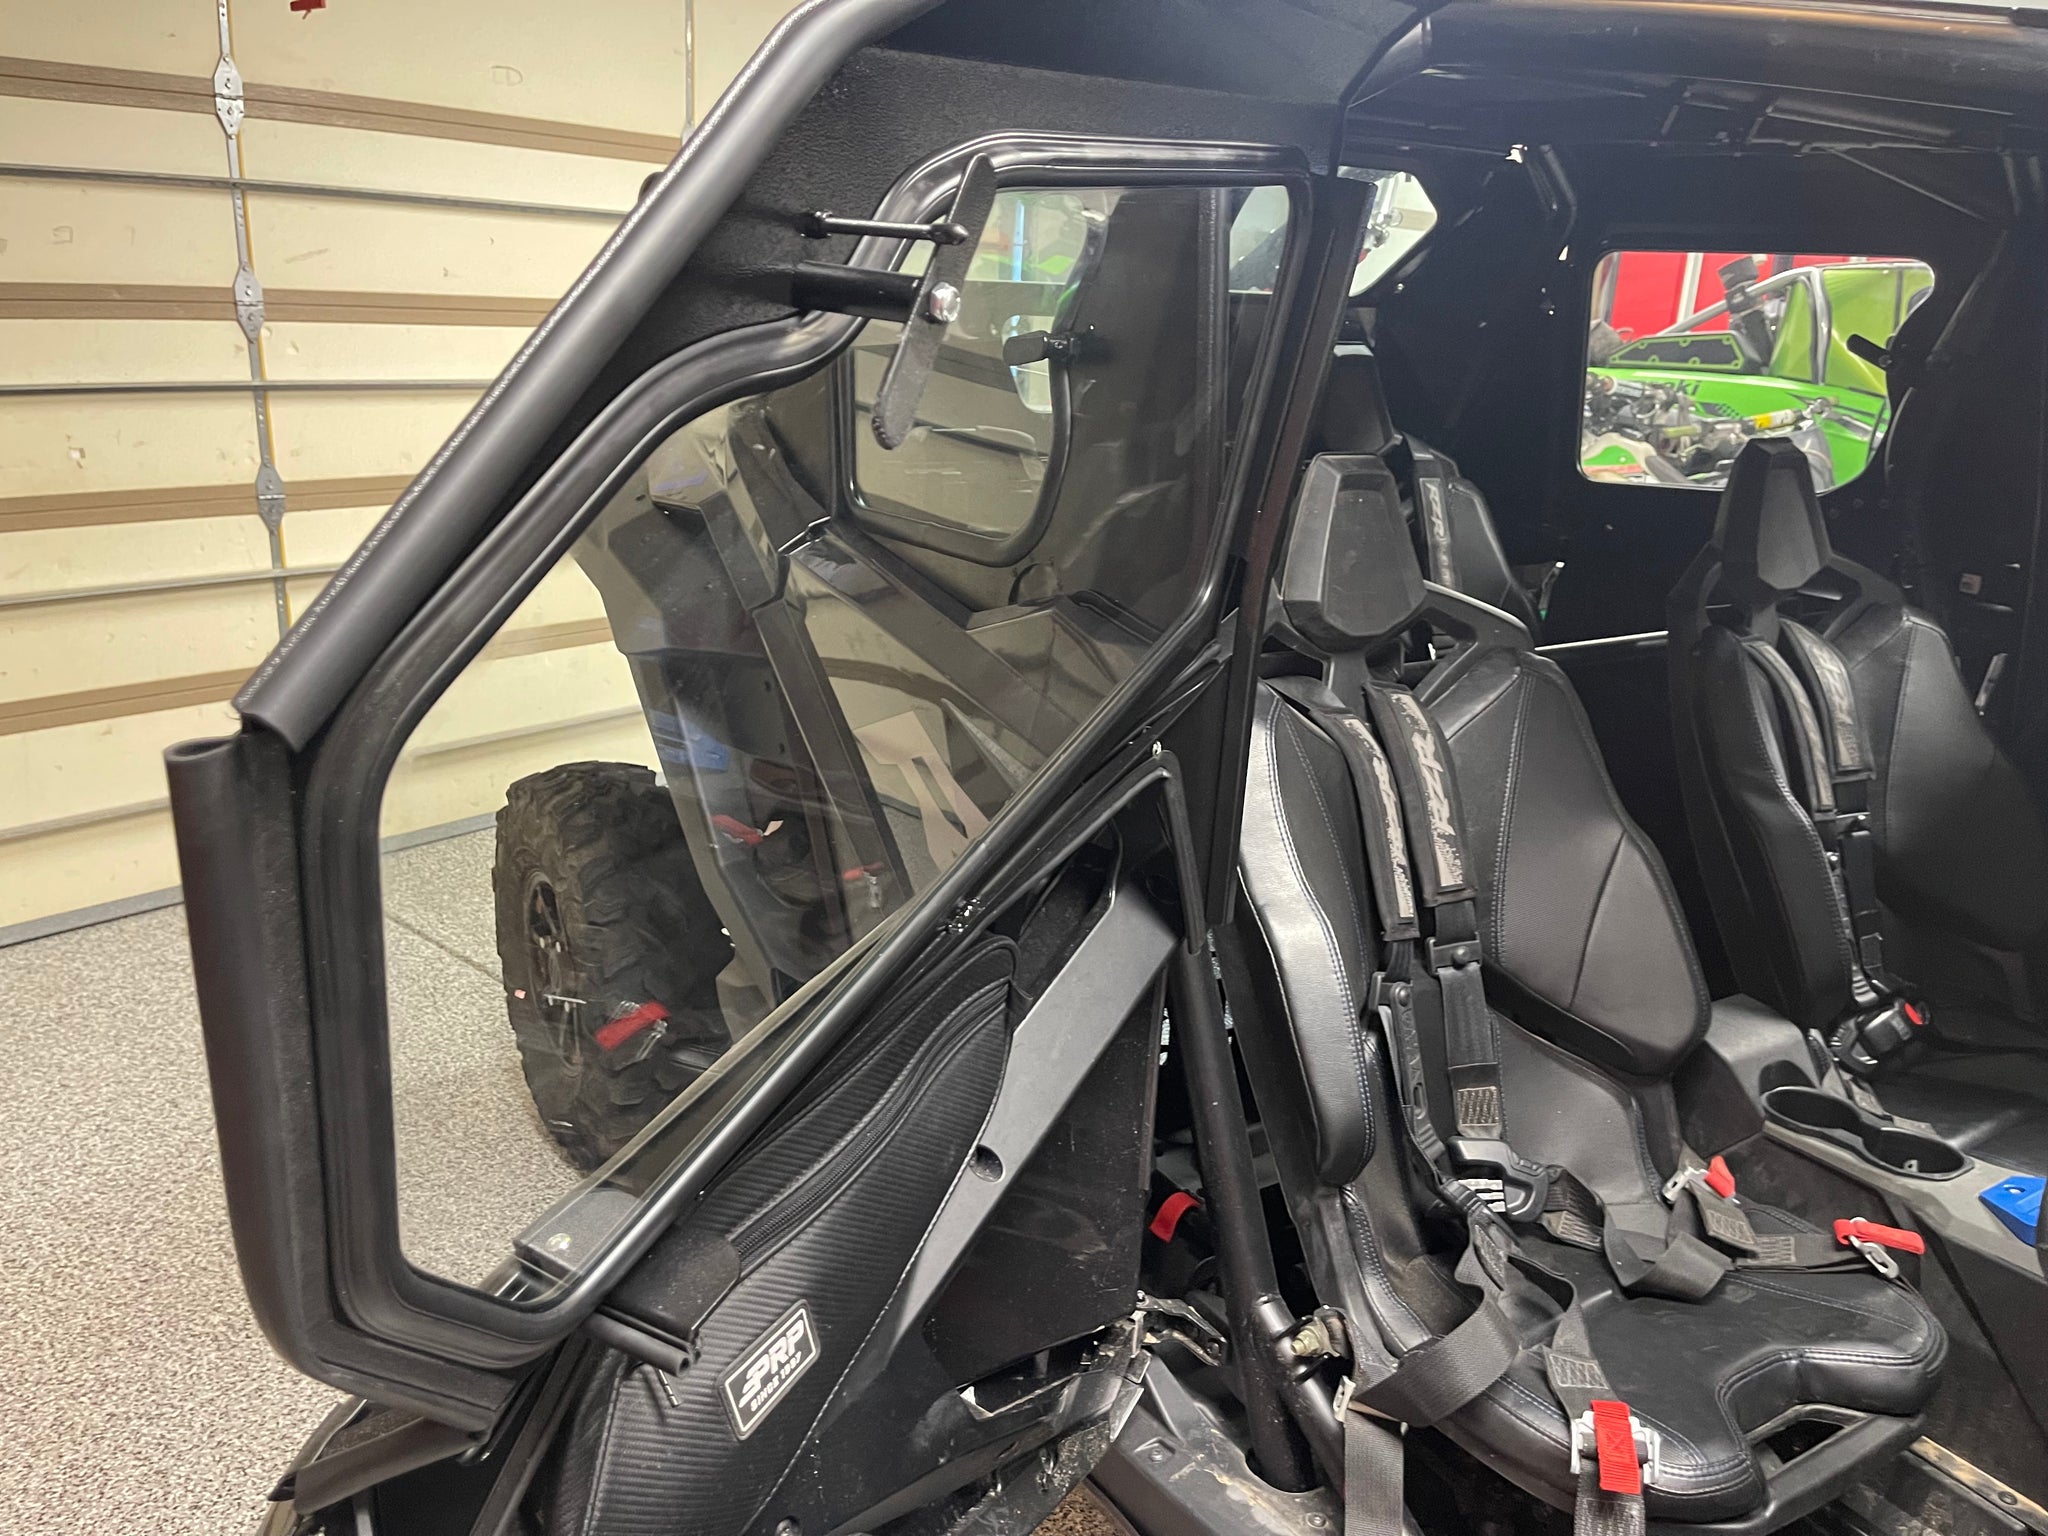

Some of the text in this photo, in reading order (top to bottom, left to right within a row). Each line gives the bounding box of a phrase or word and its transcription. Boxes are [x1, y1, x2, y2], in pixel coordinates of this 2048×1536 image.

[1411, 731, 1456, 836] RZR
[738, 1319, 805, 1409] PRP
[750, 1375, 780, 1411] SINCE
